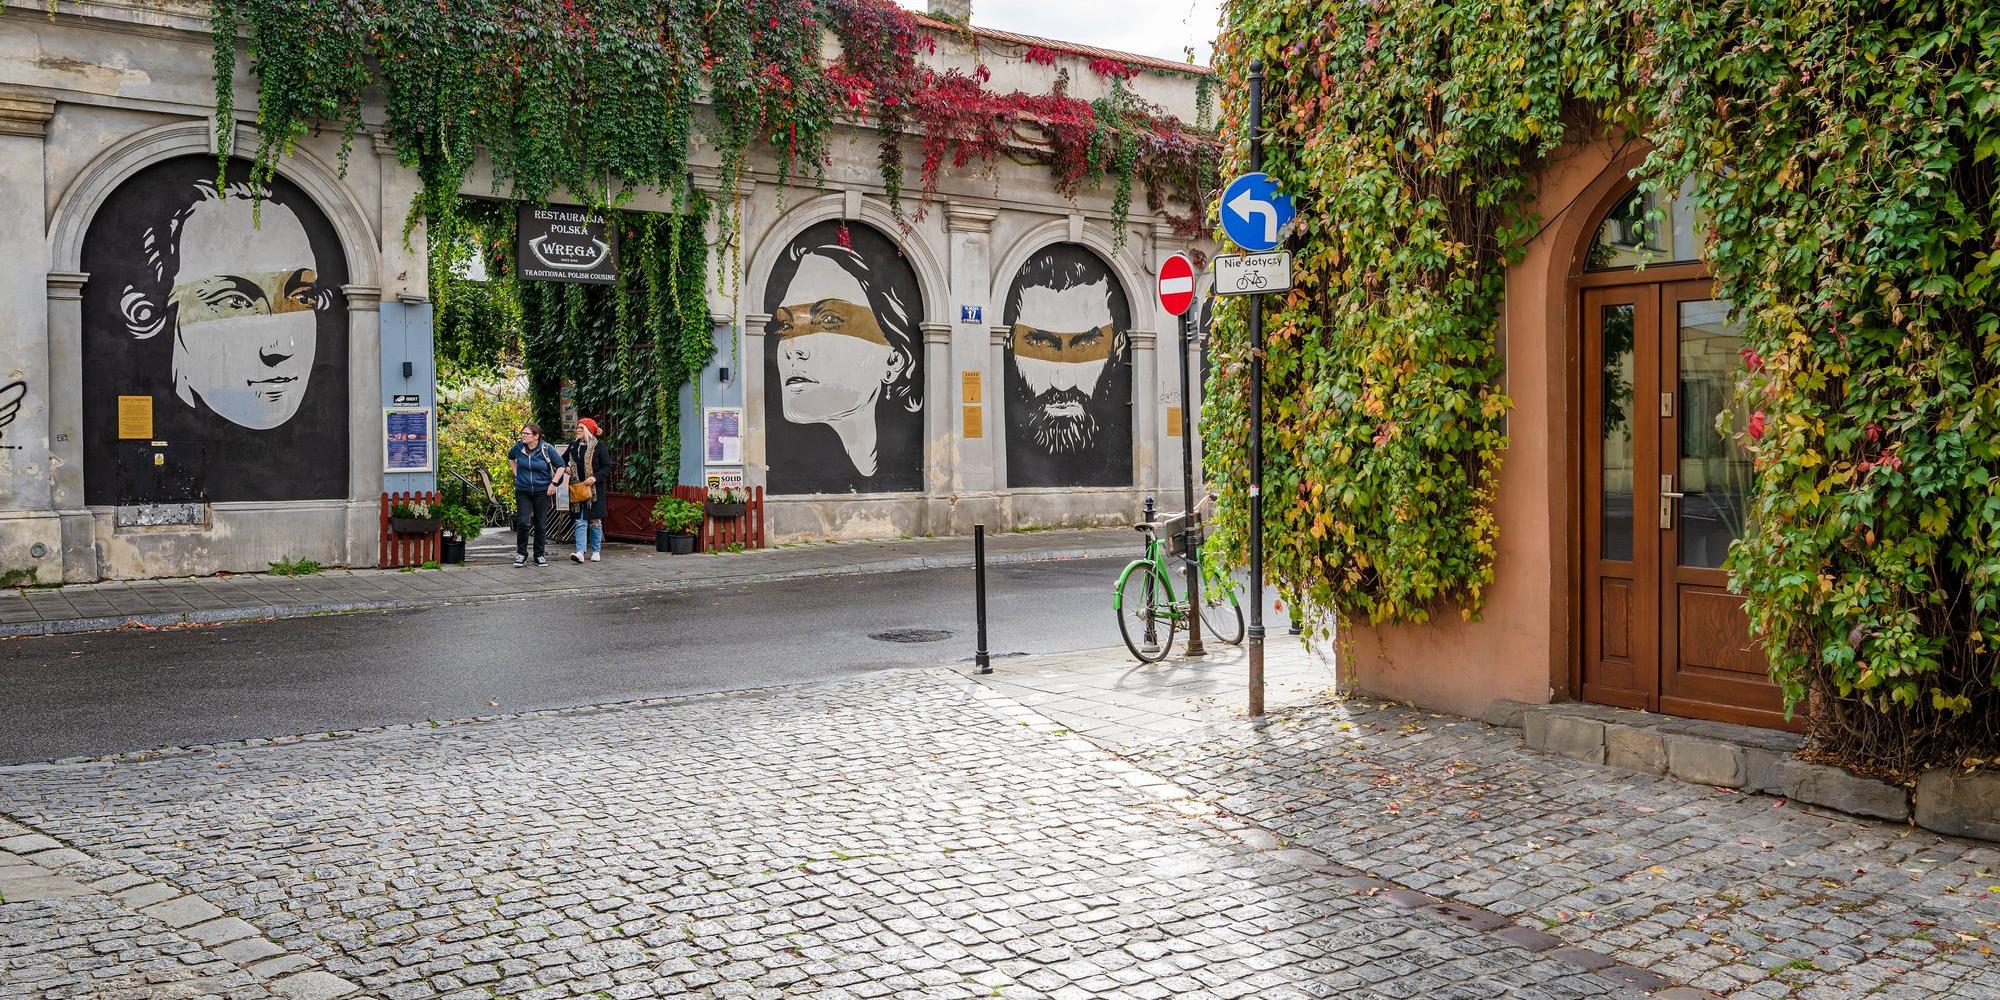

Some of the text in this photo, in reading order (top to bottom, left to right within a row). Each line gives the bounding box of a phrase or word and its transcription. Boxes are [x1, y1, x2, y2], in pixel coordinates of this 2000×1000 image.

[534, 210, 604, 223] RESTAURACJA
[551, 224, 588, 235] POLSKA
[542, 242, 597, 257] WRĘGA
[1225, 256, 1282, 268] Nie dotyczy
[525, 269, 616, 281] TRADITIONAL POLISH COUSINE
[968, 309, 976, 319] 17
